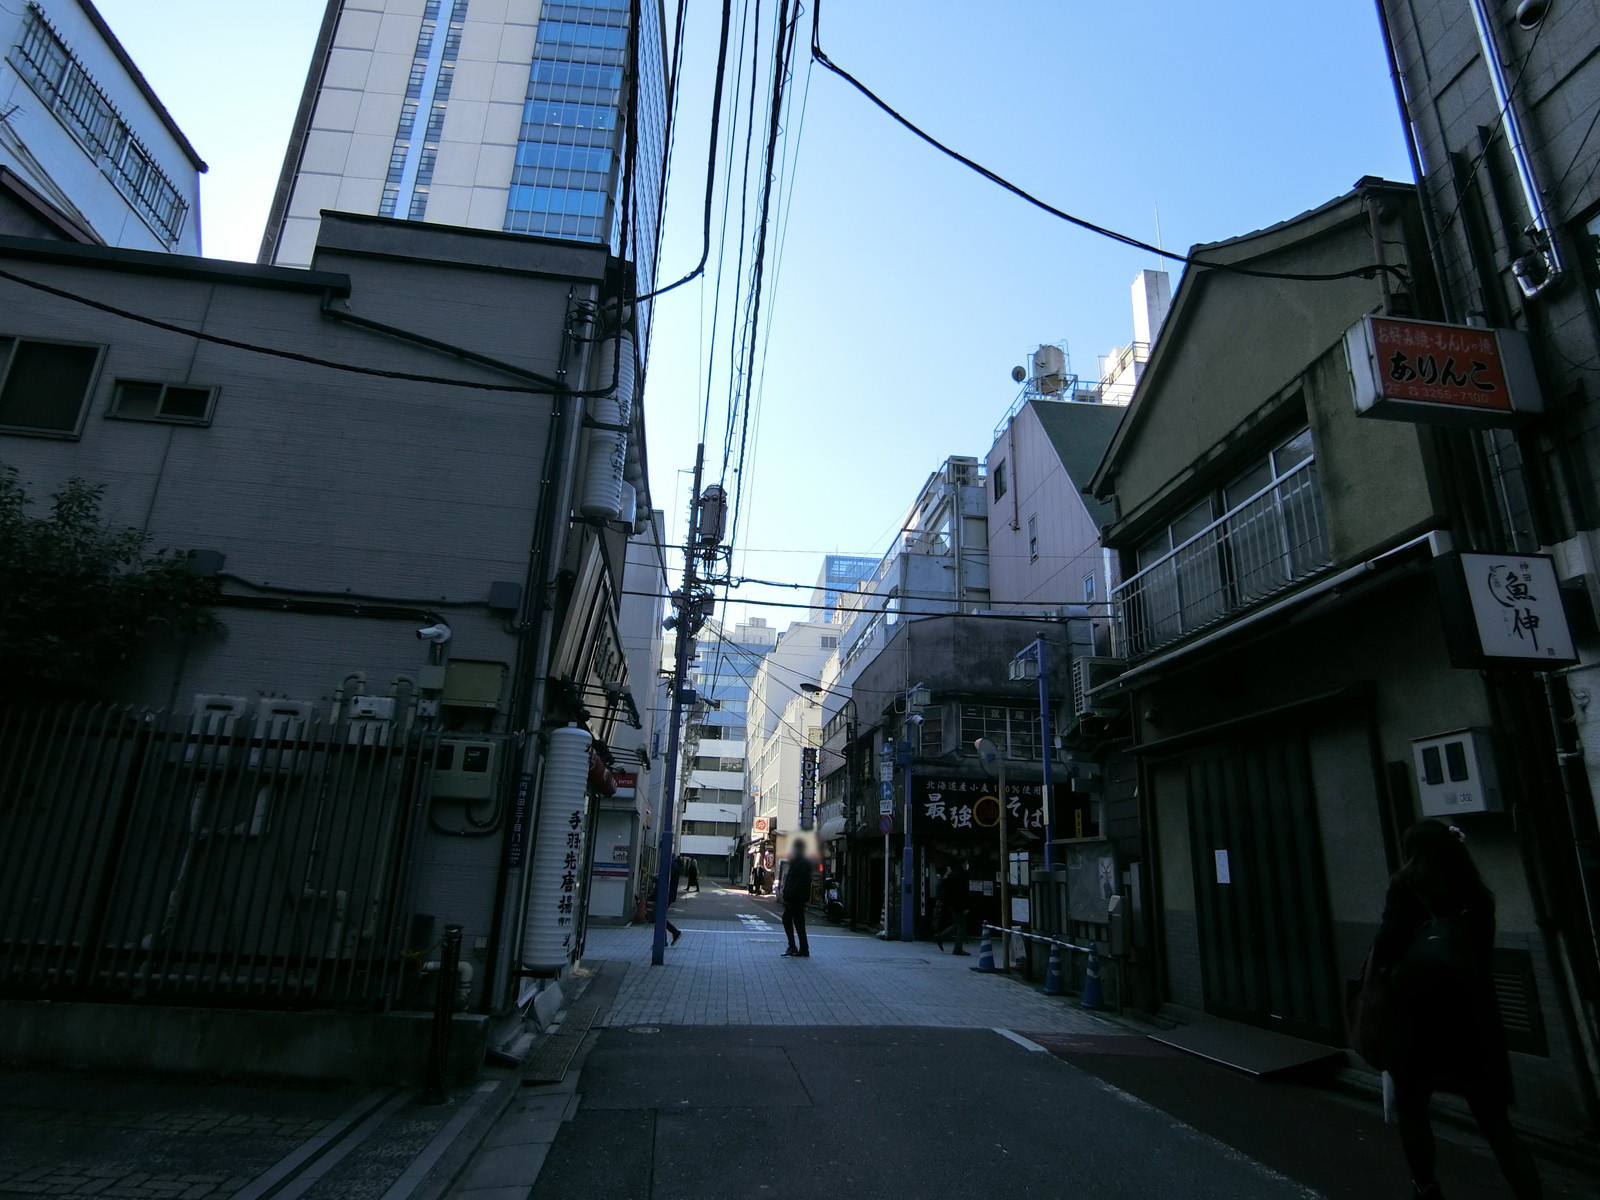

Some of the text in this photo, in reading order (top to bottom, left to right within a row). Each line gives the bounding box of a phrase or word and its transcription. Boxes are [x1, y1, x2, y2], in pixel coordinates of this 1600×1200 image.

[1389, 350, 1498, 393] ありんこ
[1385, 382, 1400, 395] 2F
[1520, 561, 1532, 582] 神田
[804, 761, 815, 789] DVD
[926, 781, 1044, 795] 北海道産小麦10%使用
[924, 793, 973, 829] 最強
[1006, 796, 1045, 829] そば
